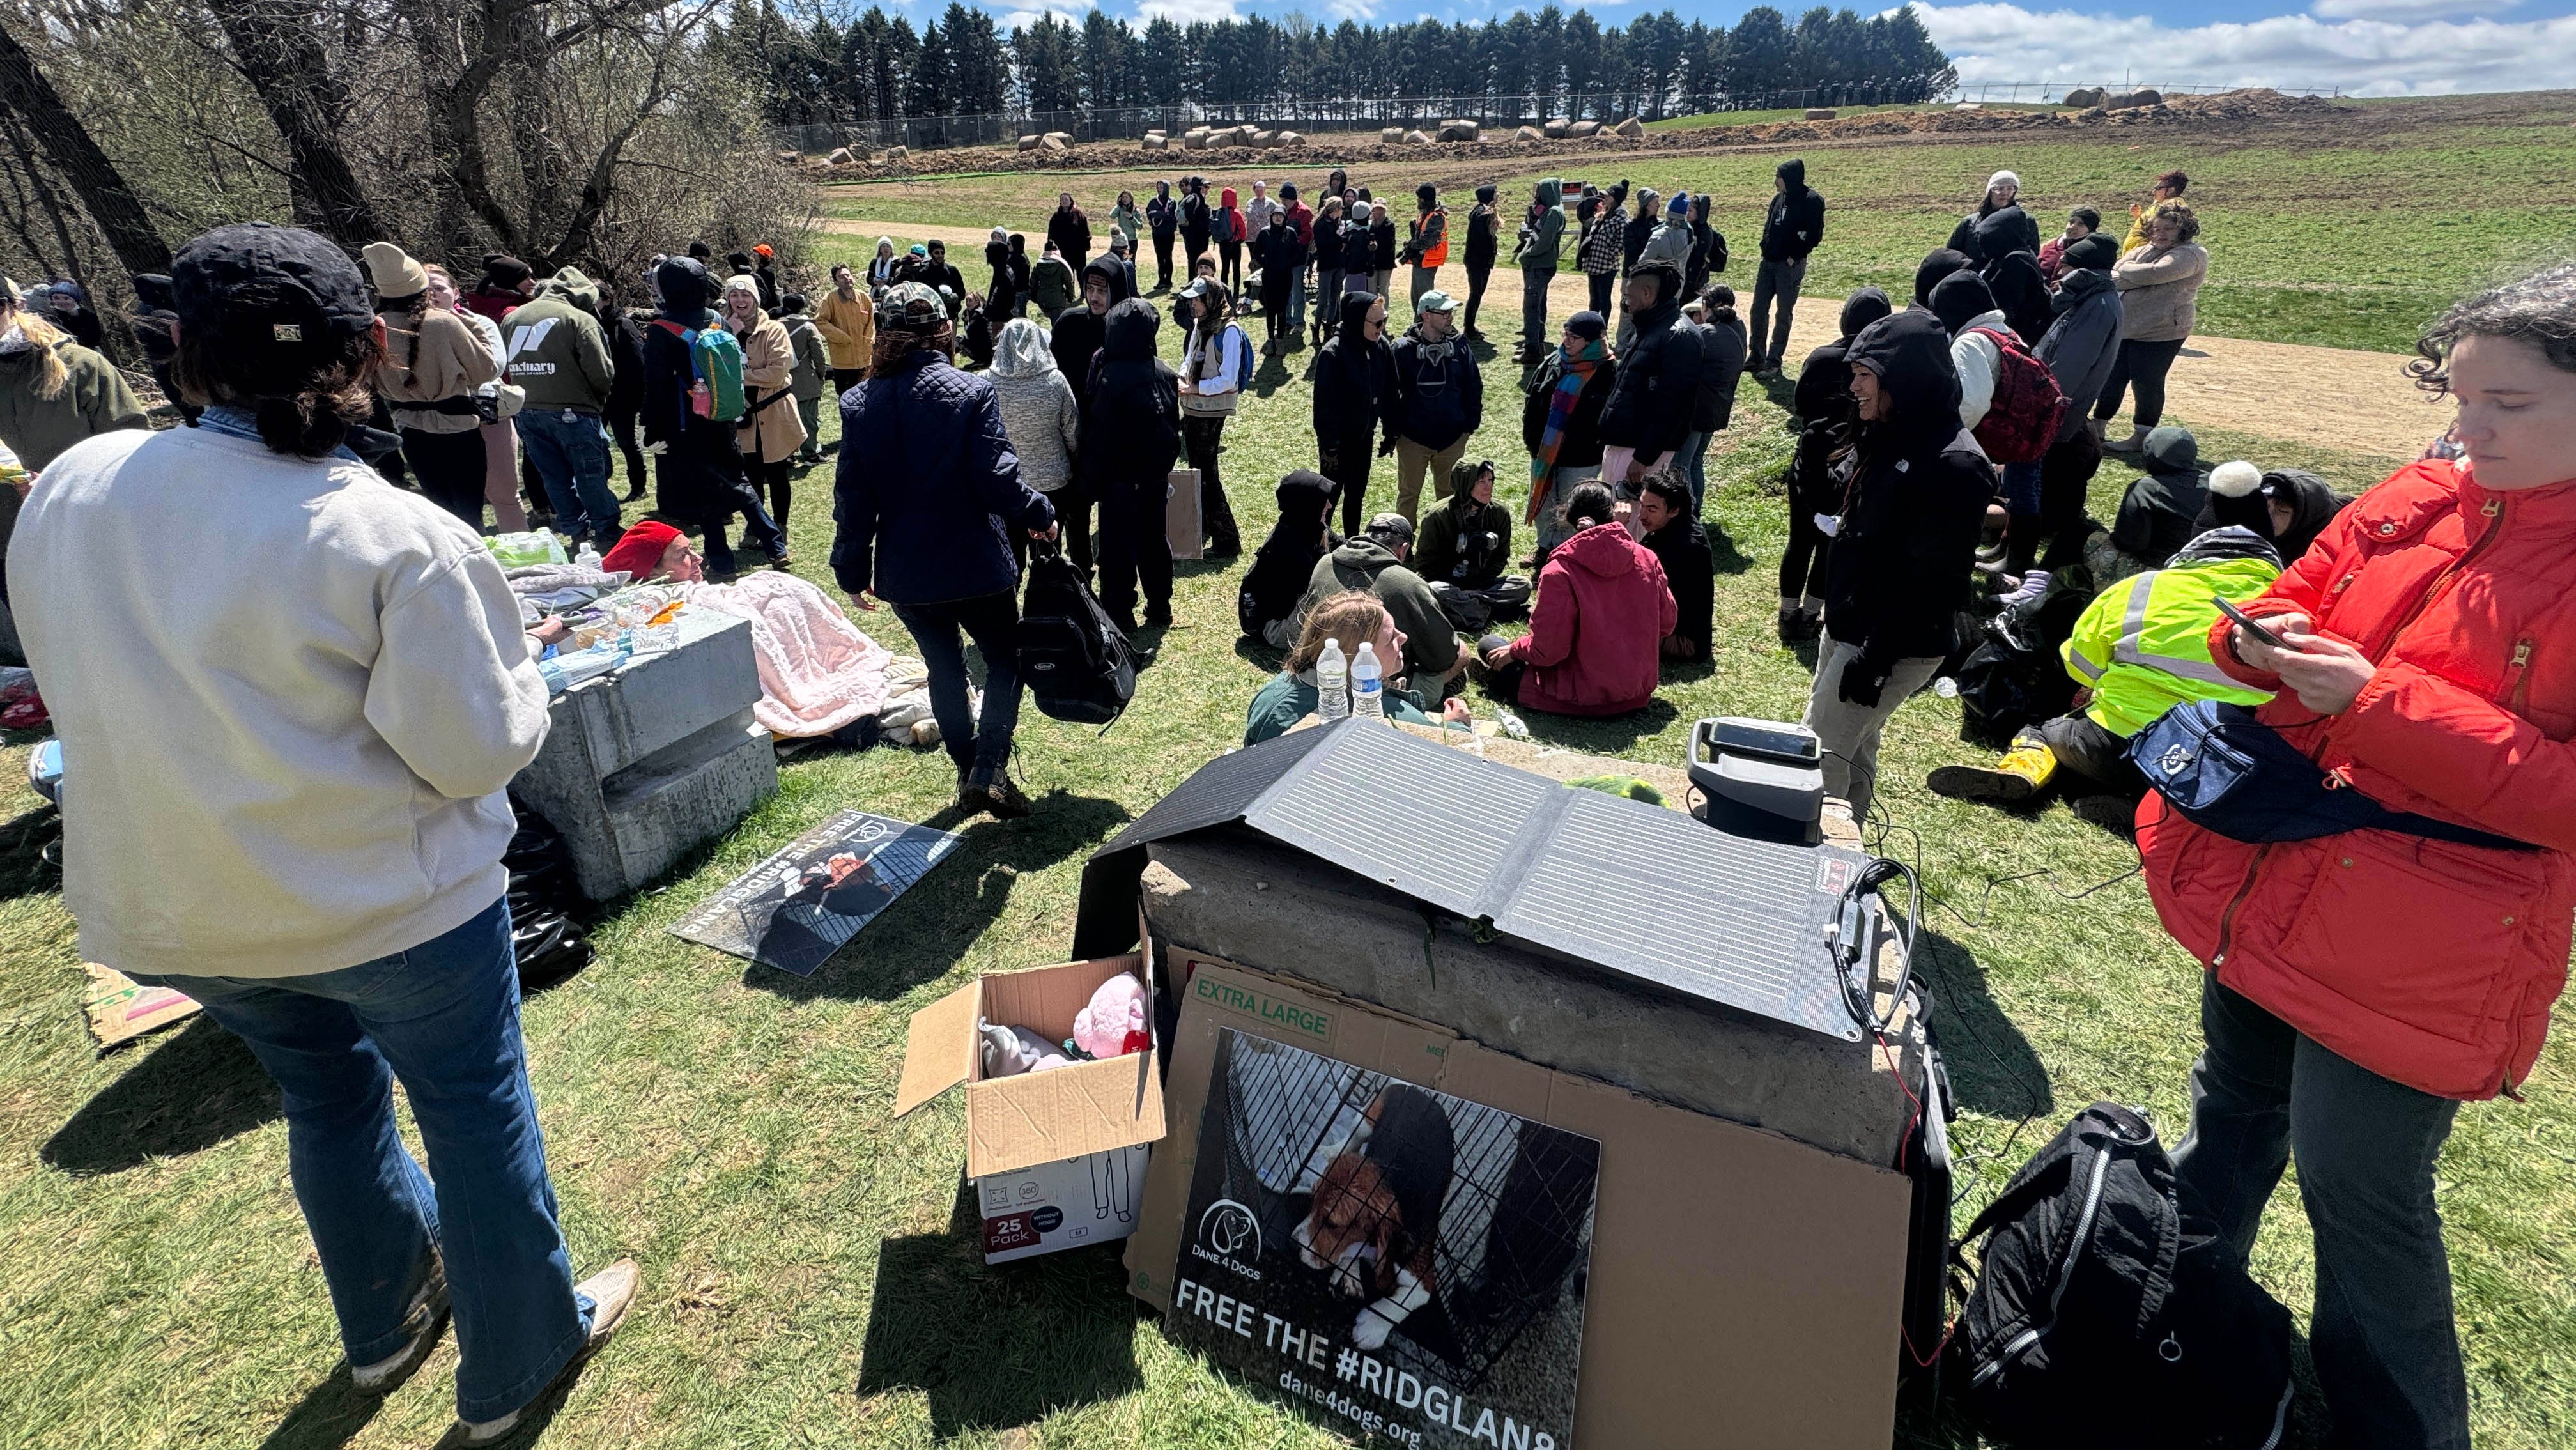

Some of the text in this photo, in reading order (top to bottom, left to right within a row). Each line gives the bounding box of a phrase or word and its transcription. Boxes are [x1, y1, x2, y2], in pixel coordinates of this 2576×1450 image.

[509, 362, 555, 374] anctuary
[819, 814, 862, 837] FREE
[787, 838, 828, 860] THE
[1197, 979, 1327, 1035] EXTRA LARGE
[1022, 1187, 1036, 1195] 360
[991, 1230, 1030, 1246] Pack
[997, 1219, 1021, 1235] 25
[1192, 1244, 1261, 1281] DANE 4 DOGS
[1176, 1278, 1255, 1338] FREE
[1263, 1313, 1329, 1371] THE
